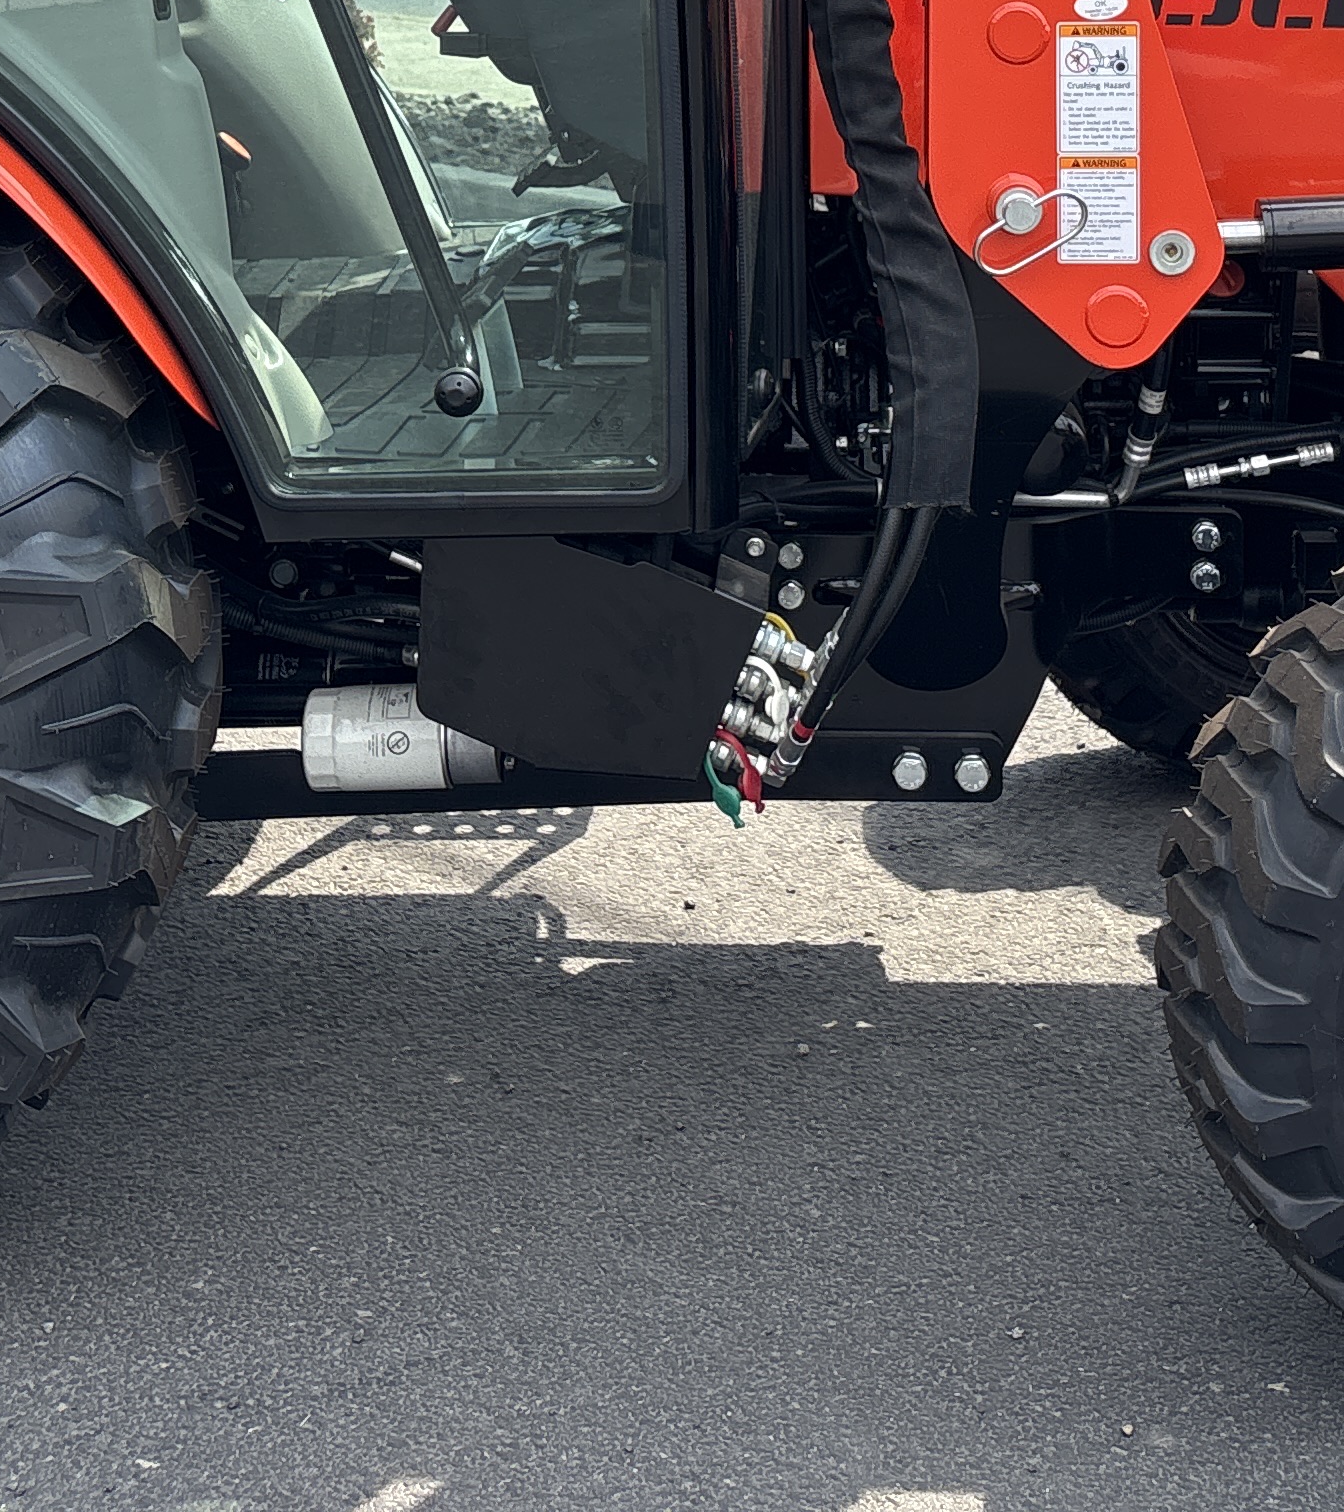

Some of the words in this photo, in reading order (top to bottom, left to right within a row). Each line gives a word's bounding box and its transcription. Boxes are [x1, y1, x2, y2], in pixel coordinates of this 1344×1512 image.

[1082, 26, 1127, 35] WARNING
[1067, 82, 1100, 90] Crushing
[1082, 159, 1127, 168] WARNING
